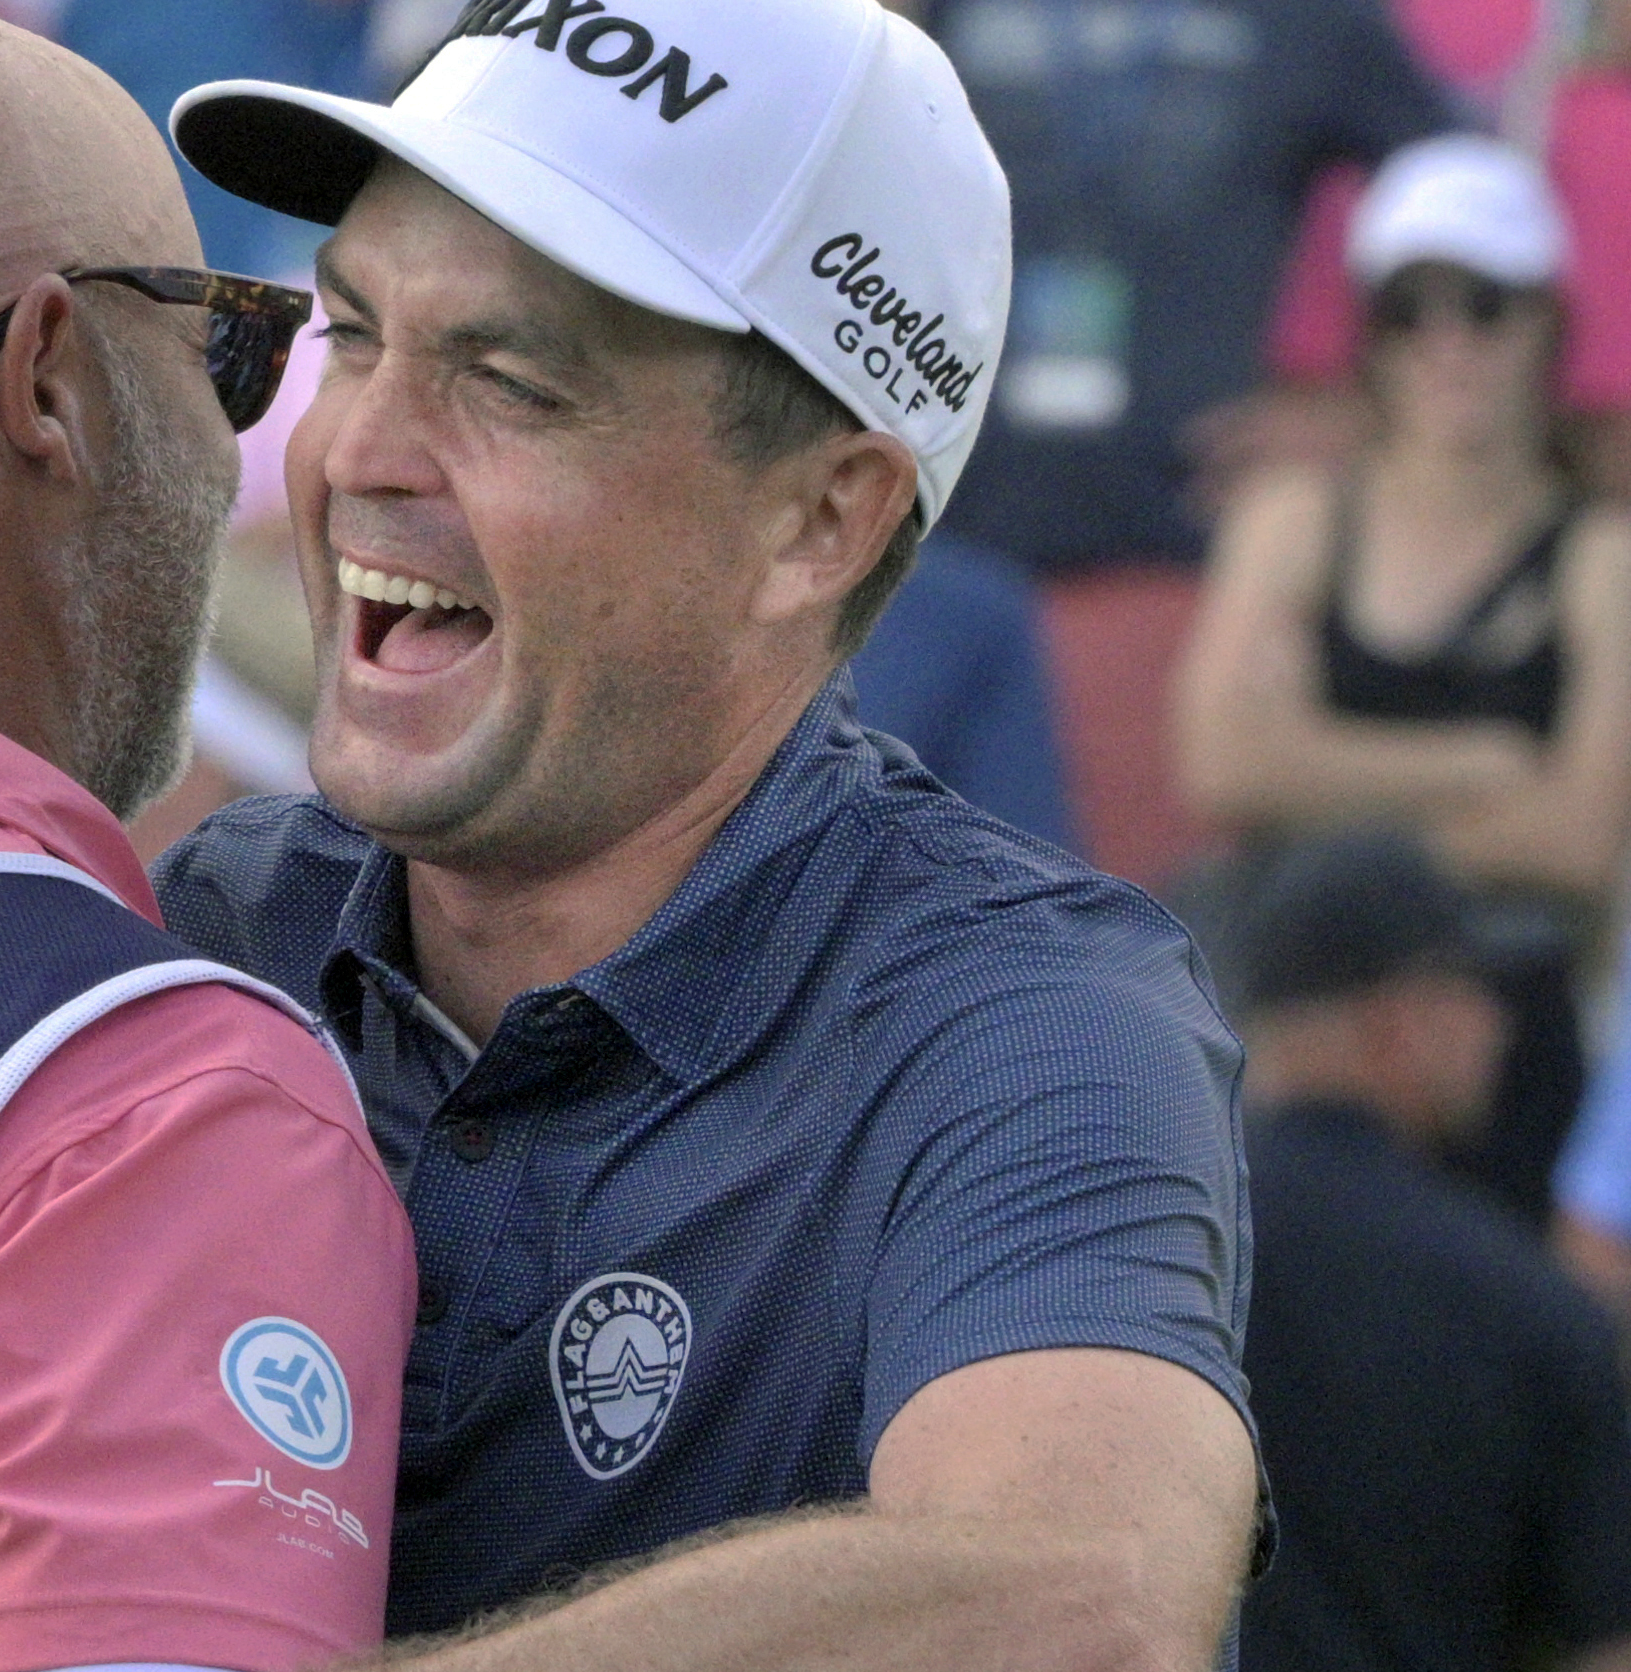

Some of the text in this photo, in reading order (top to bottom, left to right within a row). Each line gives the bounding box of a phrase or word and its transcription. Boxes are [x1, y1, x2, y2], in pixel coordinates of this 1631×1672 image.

[810, 232, 983, 413] Cleveland
[834, 319, 930, 415] GOLF
[258, 1496, 350, 1545] AUDIO
